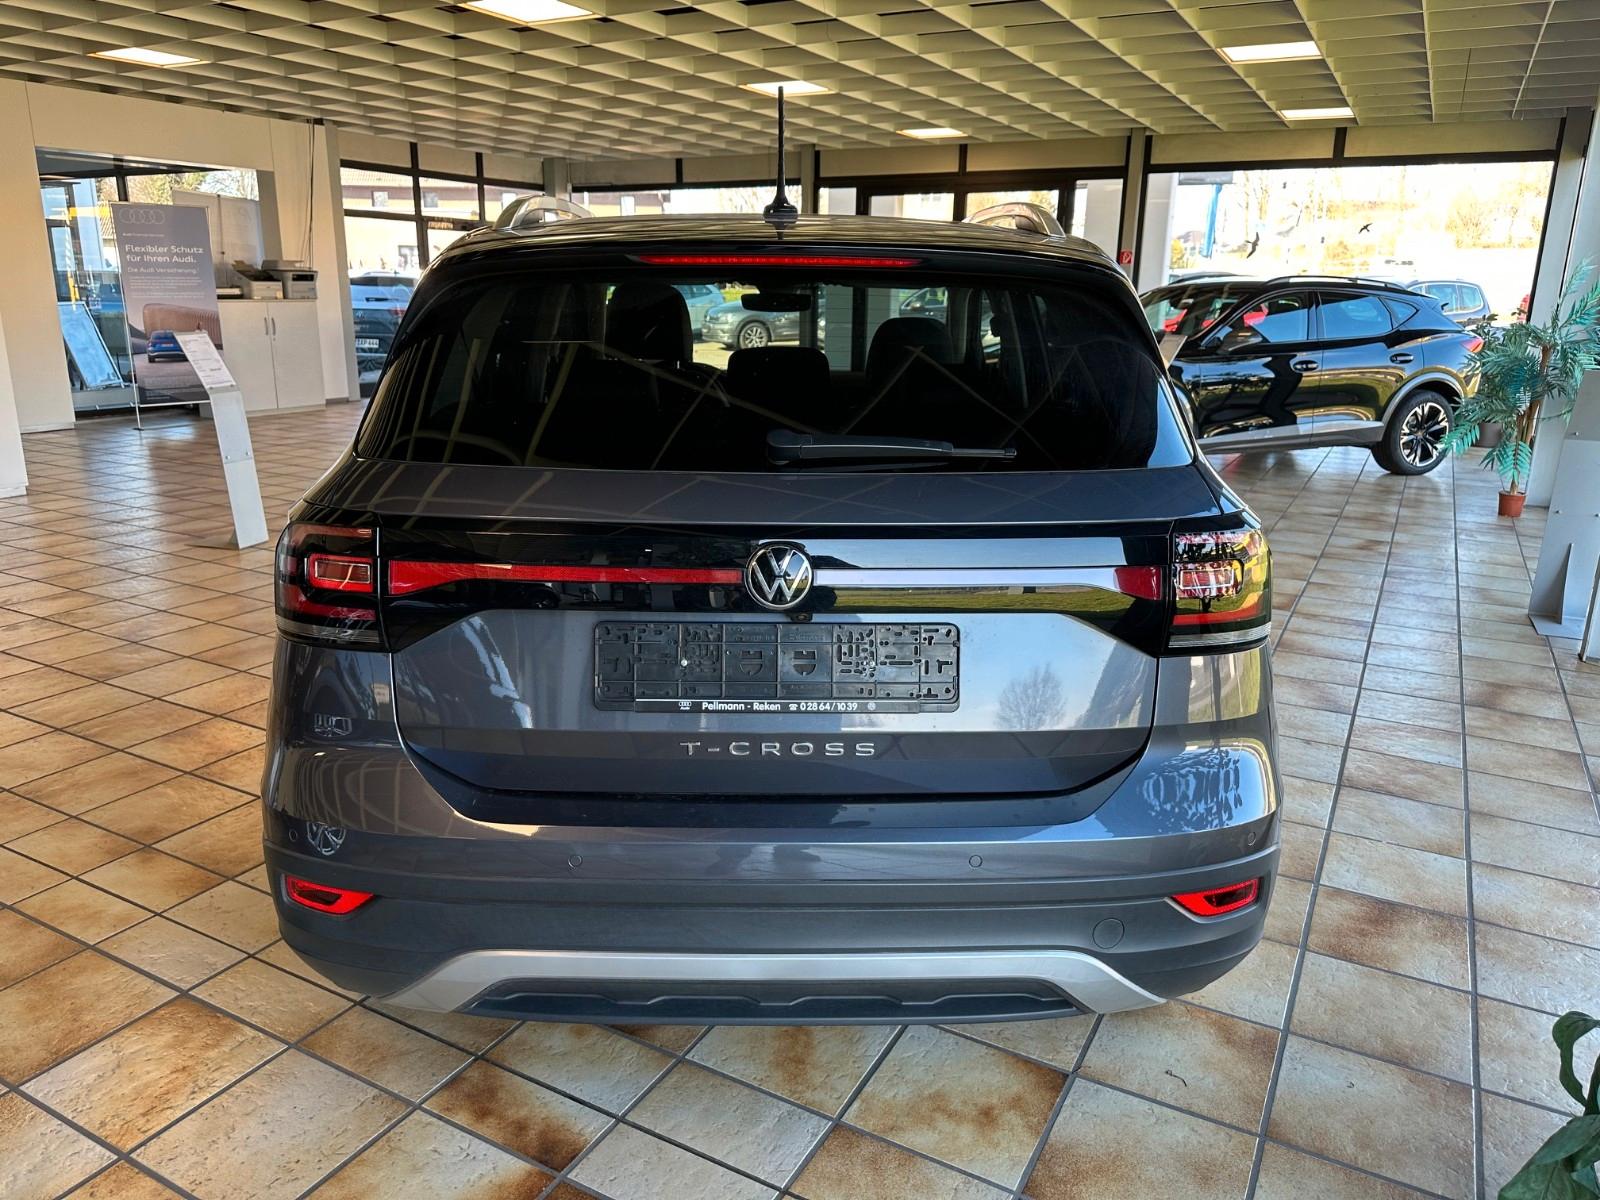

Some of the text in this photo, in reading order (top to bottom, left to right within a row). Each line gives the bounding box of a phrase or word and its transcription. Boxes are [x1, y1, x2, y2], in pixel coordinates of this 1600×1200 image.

[125, 244, 204, 254] Flexibler Schutz
[126, 254, 141, 262] für
[702, 701, 745, 711] Pellmann
[753, 702, 780, 711] Reken
[679, 741, 875, 756] T-CROSS
